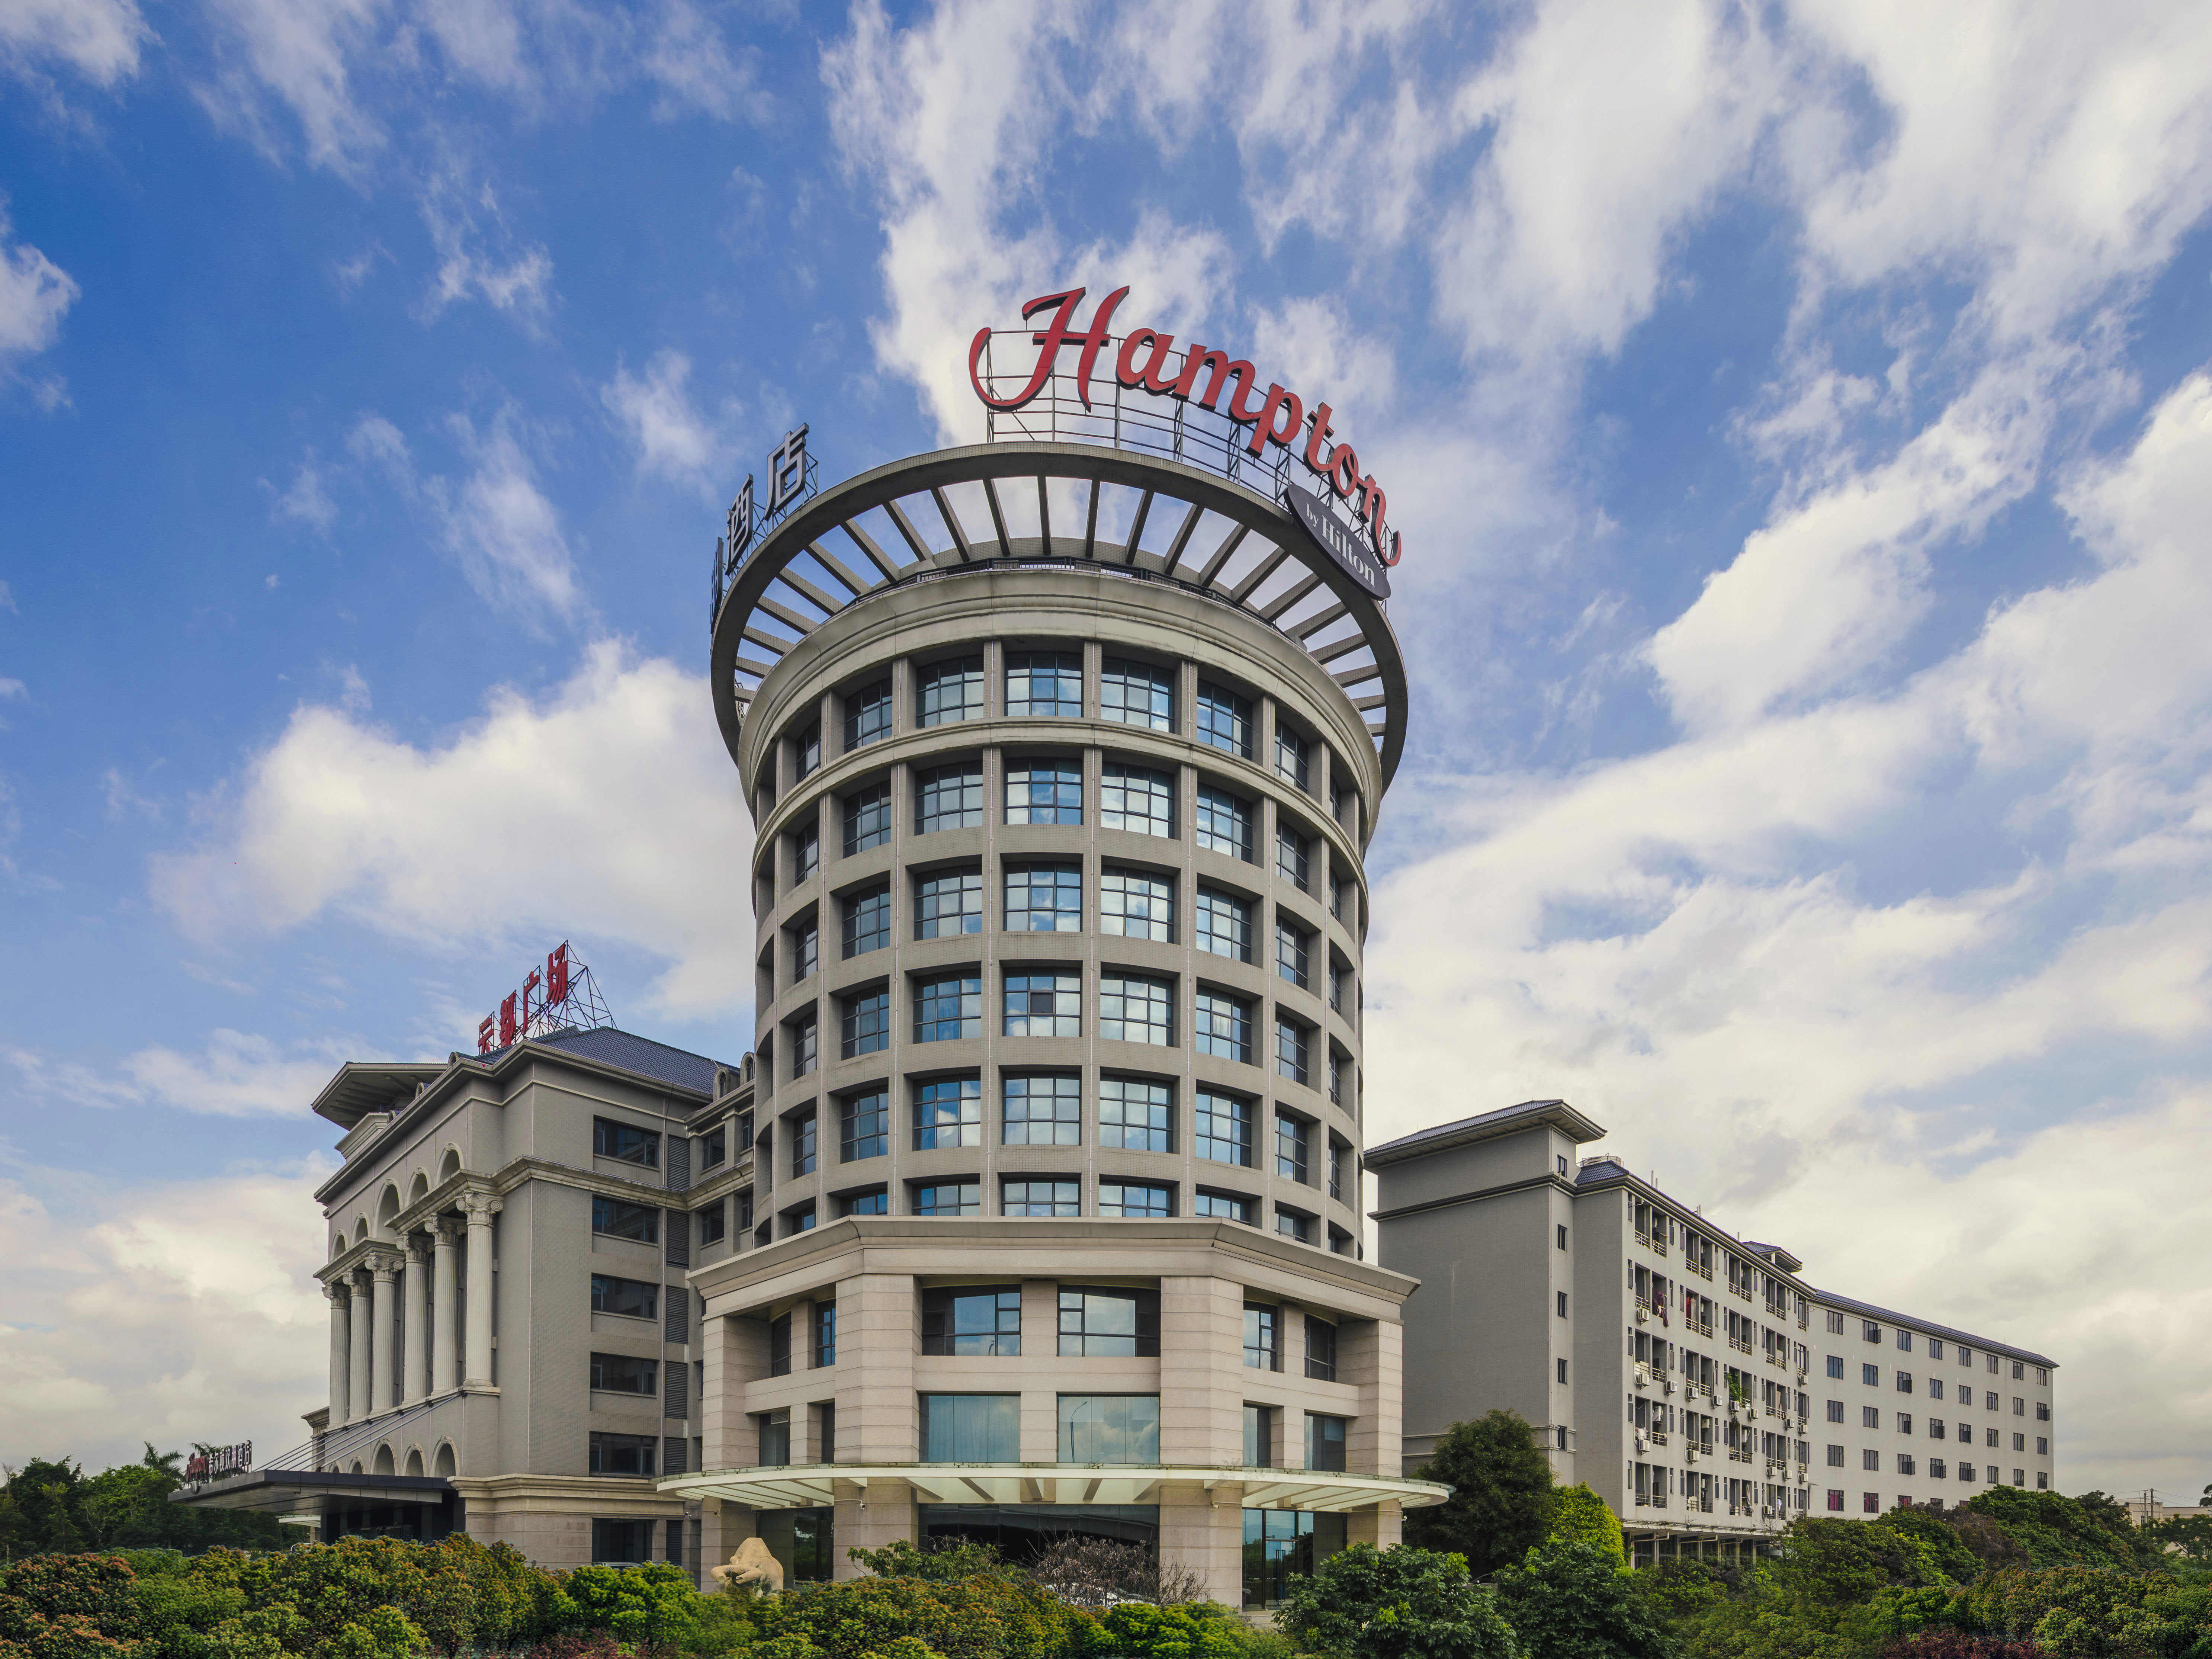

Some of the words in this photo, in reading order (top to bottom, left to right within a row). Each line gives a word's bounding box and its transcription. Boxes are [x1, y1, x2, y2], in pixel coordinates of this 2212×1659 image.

[969, 285, 1401, 568] Hampton
[1306, 503, 1319, 527] by
[1322, 514, 1375, 587] Hilton
